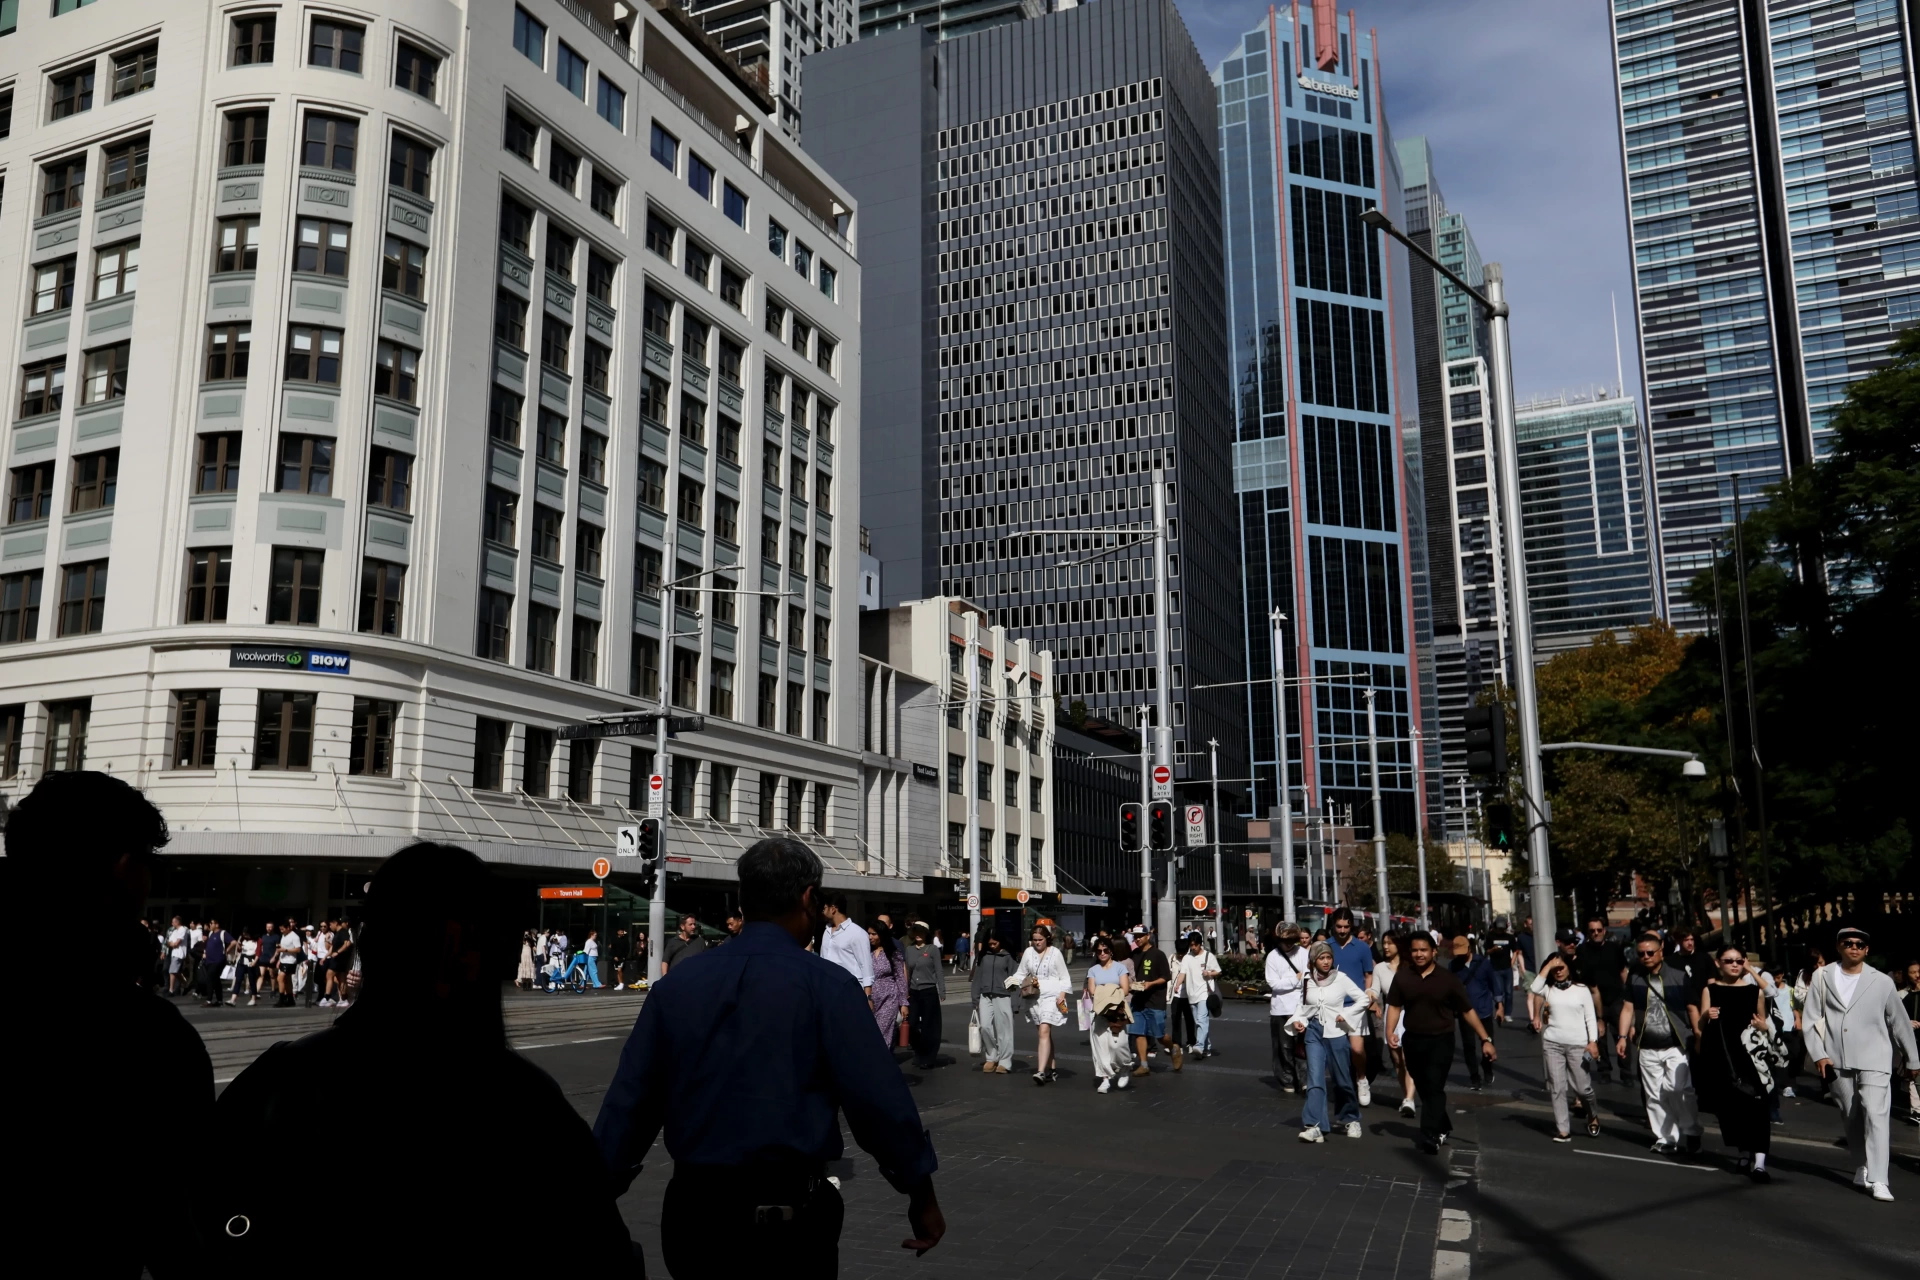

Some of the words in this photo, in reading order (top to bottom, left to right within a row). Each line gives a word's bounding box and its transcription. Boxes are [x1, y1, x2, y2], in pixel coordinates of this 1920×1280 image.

[1311, 78, 1359, 99] breathe
[598, 862, 605, 875] T
[1020, 893, 1026, 901] T
[1196, 898, 1204, 909] T
